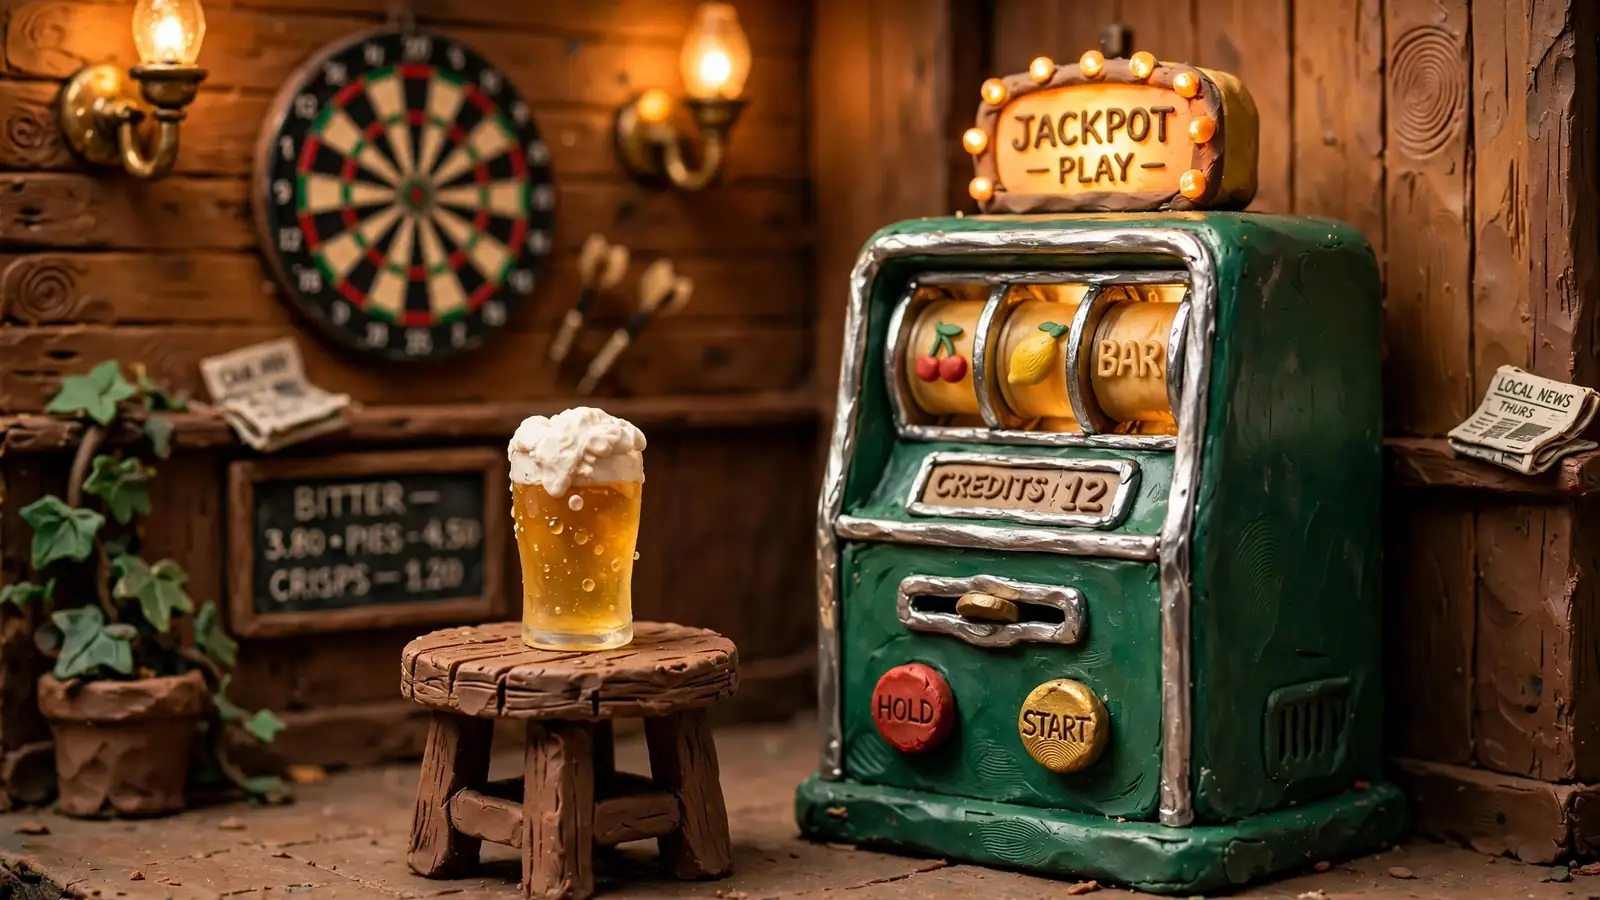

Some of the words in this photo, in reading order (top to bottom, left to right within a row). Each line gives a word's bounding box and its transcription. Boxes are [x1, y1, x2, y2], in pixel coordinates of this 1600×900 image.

[1012, 106, 1176, 151] JACKPOT
[1059, 153, 1135, 184] PLAY
[1098, 339, 1166, 379] BAR
[1497, 377, 1534, 399] LOCAL
[1537, 387, 1574, 408] NEWS
[1499, 400, 1535, 419] THURS
[294, 482, 405, 521] BITTER
[935, 472, 1050, 502] CREDITS
[1060, 475, 1108, 512] 12
[269, 562, 371, 602] CRISPS
[877, 695, 934, 724] HOLD
[1022, 709, 1092, 743] START
